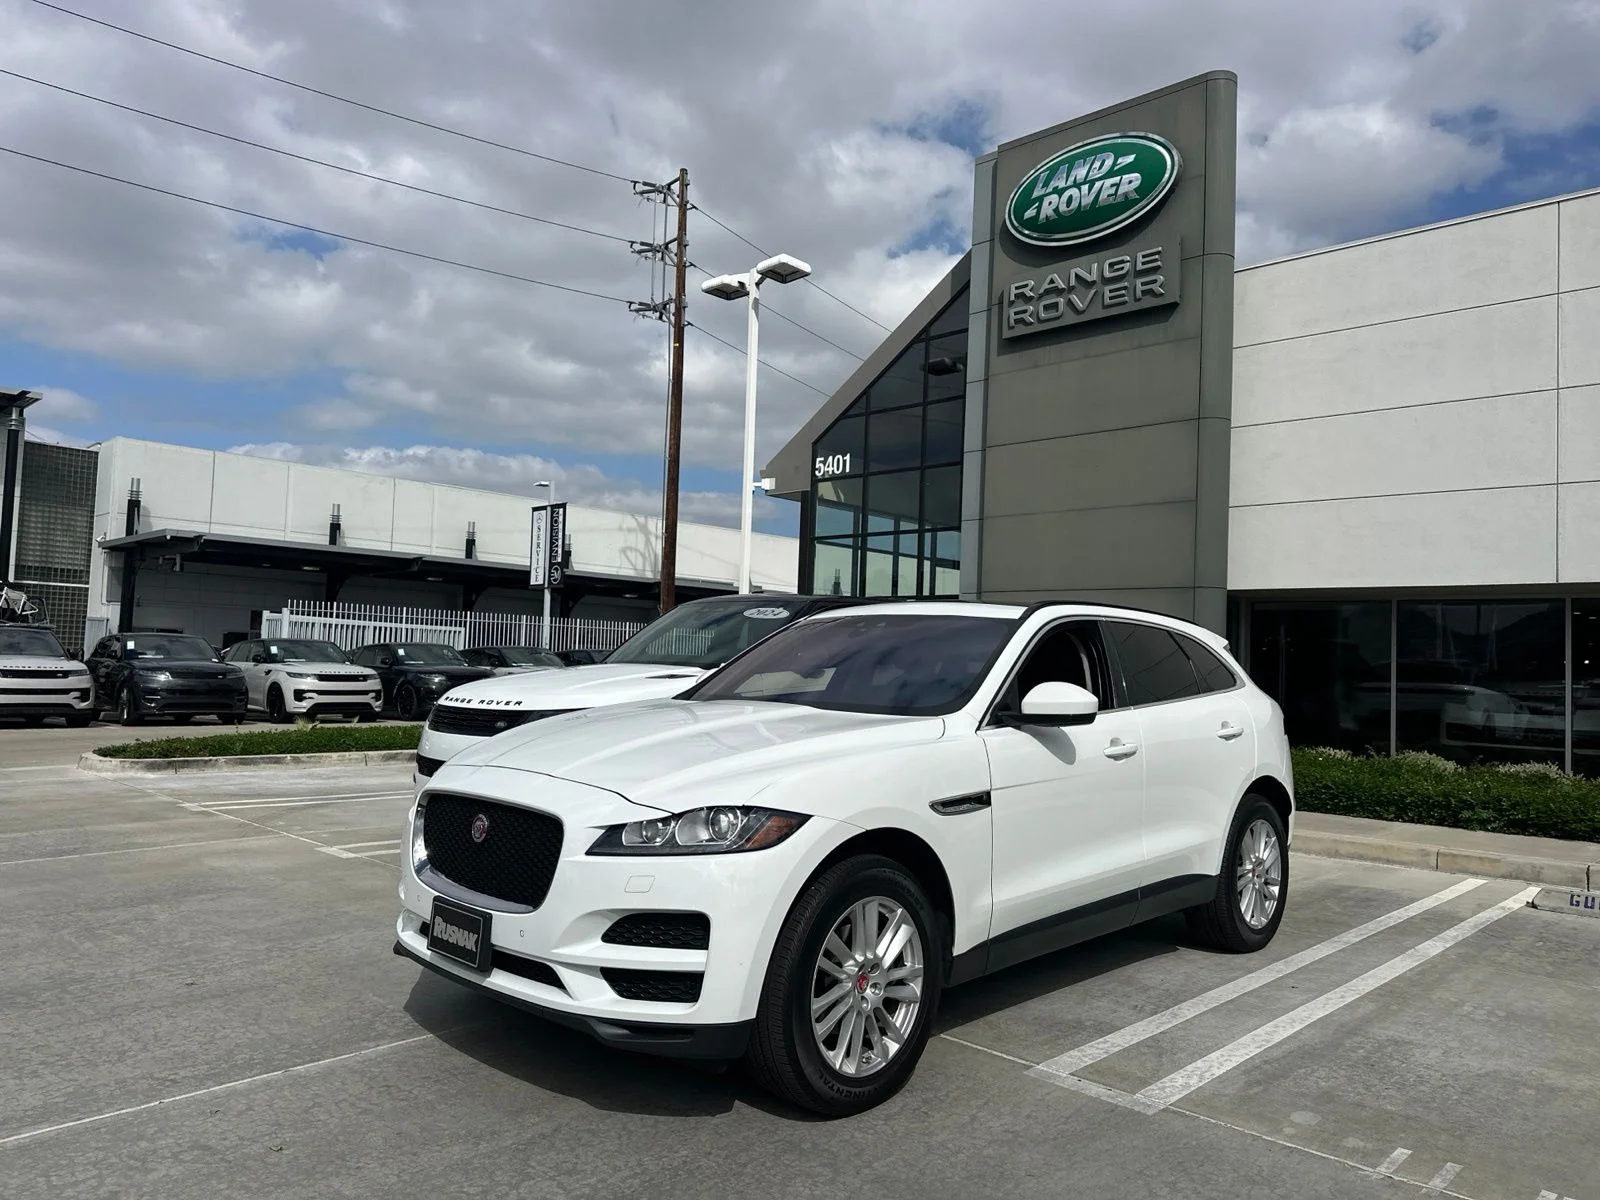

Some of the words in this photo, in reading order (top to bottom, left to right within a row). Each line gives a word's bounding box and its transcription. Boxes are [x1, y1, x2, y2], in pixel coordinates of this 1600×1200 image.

[1032, 152, 1115, 198] LAND
[1038, 172, 1142, 224] ROVER
[1008, 246, 1164, 304] RANGE
[1008, 274, 1165, 329] ROVER
[815, 452, 851, 477] 5401
[552, 508, 560, 563] ENVISION
[444, 696, 474, 705] RANGE
[1570, 894, 1600, 910] GU
[433, 915, 479, 953] RUSNAK
